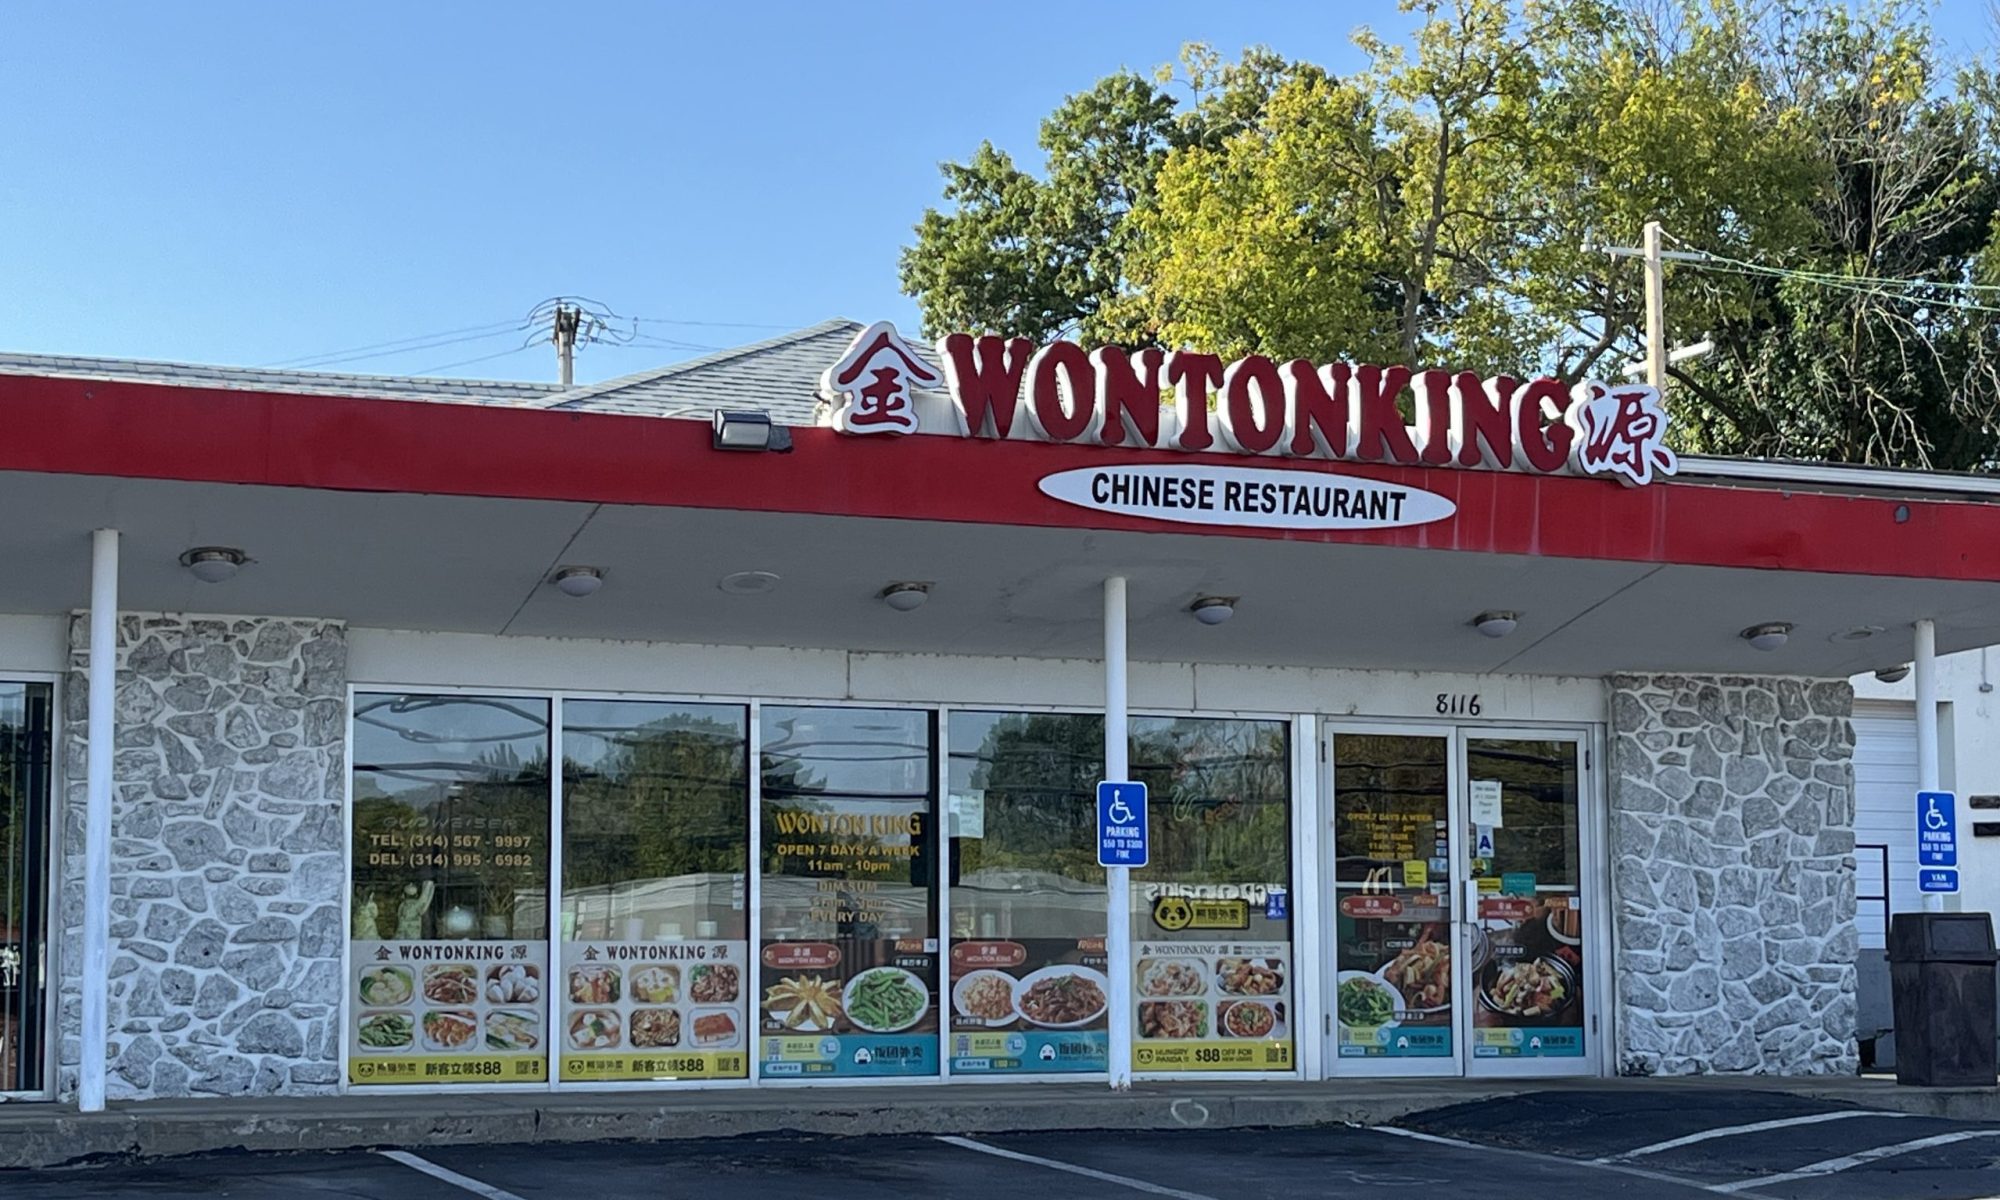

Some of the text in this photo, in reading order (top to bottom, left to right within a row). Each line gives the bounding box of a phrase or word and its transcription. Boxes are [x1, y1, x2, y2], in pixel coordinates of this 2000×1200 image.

[837, 331, 1671, 478] 金 WONTONKING 源
[1091, 472, 1407, 522] CHINESE RESTAURANT
[1435, 693, 1481, 717] 8116
[870, 813, 922, 836] KING
[1105, 825, 1141, 838] PARKING
[369, 833, 404, 847] TEL:
[409, 834, 449, 849] (314)
[452, 835, 482, 848] 567
[494, 836, 532, 849] 9997
[1117, 839, 1125, 849] TO
[1478, 834, 1492, 850] A
[1923, 831, 1952, 842] PARKING
[776, 844, 920, 857] OPEN 7 DAYS A WEEK
[1115, 849, 1130, 860] FINE
[369, 852, 404, 866] DEL:
[409, 853, 449, 868] (314)
[452, 854, 482, 867] 995
[494, 854, 532, 868] 6982
[807, 859, 844, 871] 11am
[855, 860, 891, 873] 10pm
[1931, 873, 1947, 881] VAN
[859, 911, 886, 923] DAY
[399, 945, 504, 960] WONTONKING
[606, 945, 707, 960] WONTONKING
[1194, 1048, 1222, 1063] $88
[1238, 1048, 1253, 1056] FOR
